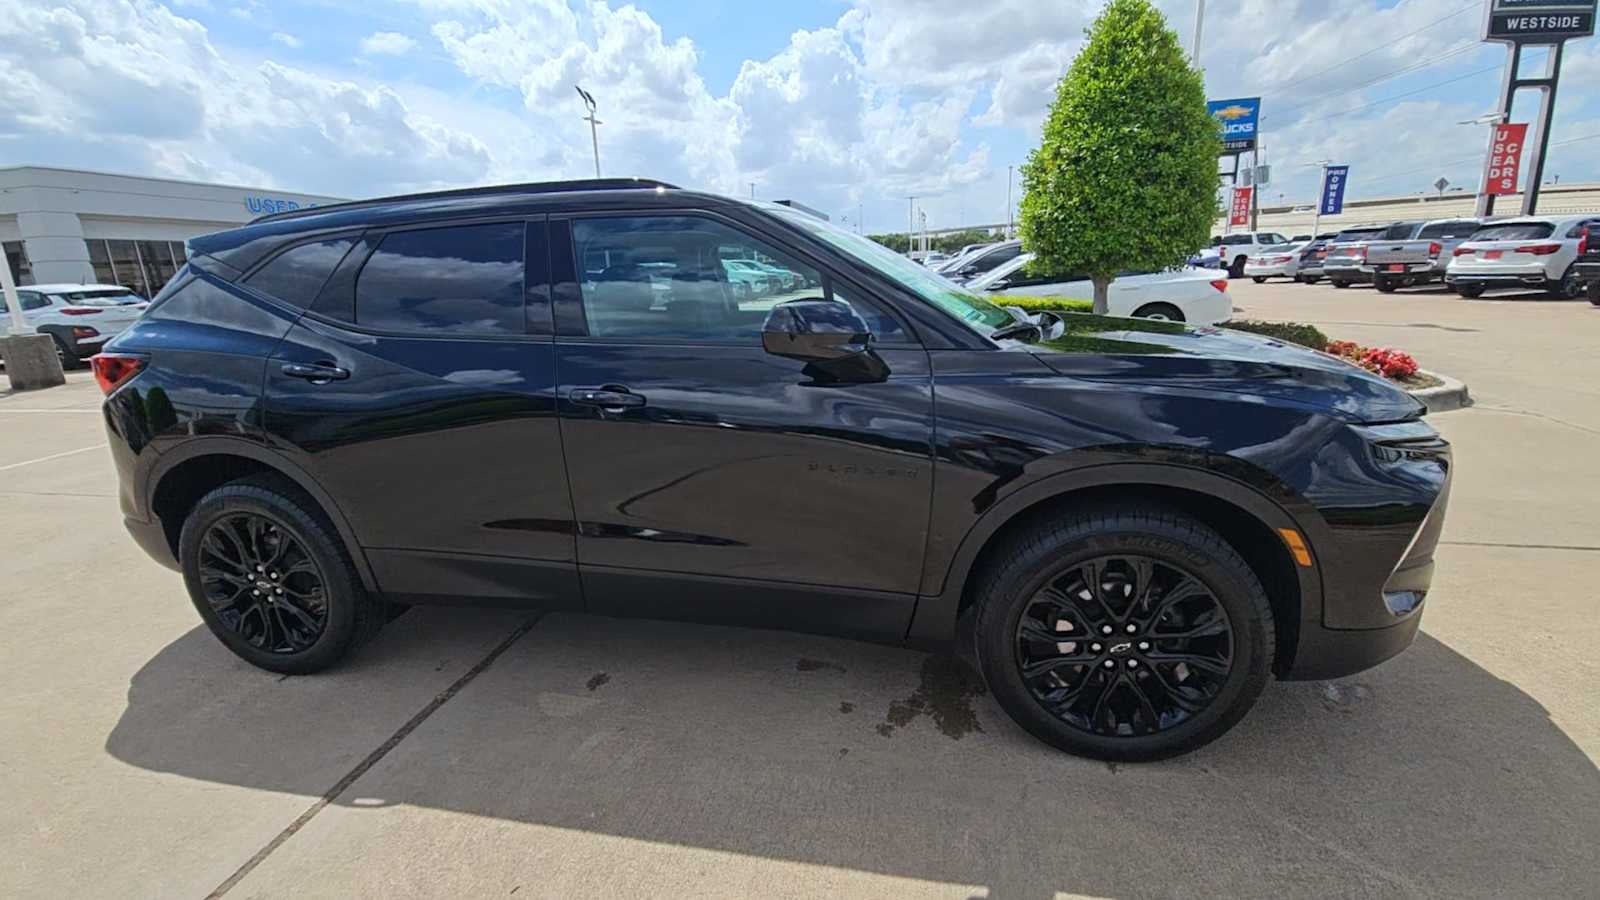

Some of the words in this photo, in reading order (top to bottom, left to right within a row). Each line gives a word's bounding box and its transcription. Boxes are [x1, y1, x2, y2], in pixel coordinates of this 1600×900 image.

[1506, 16, 1580, 30] WESTSIDE
[1489, 130, 1509, 179] USED
[1501, 143, 1518, 189] CARS
